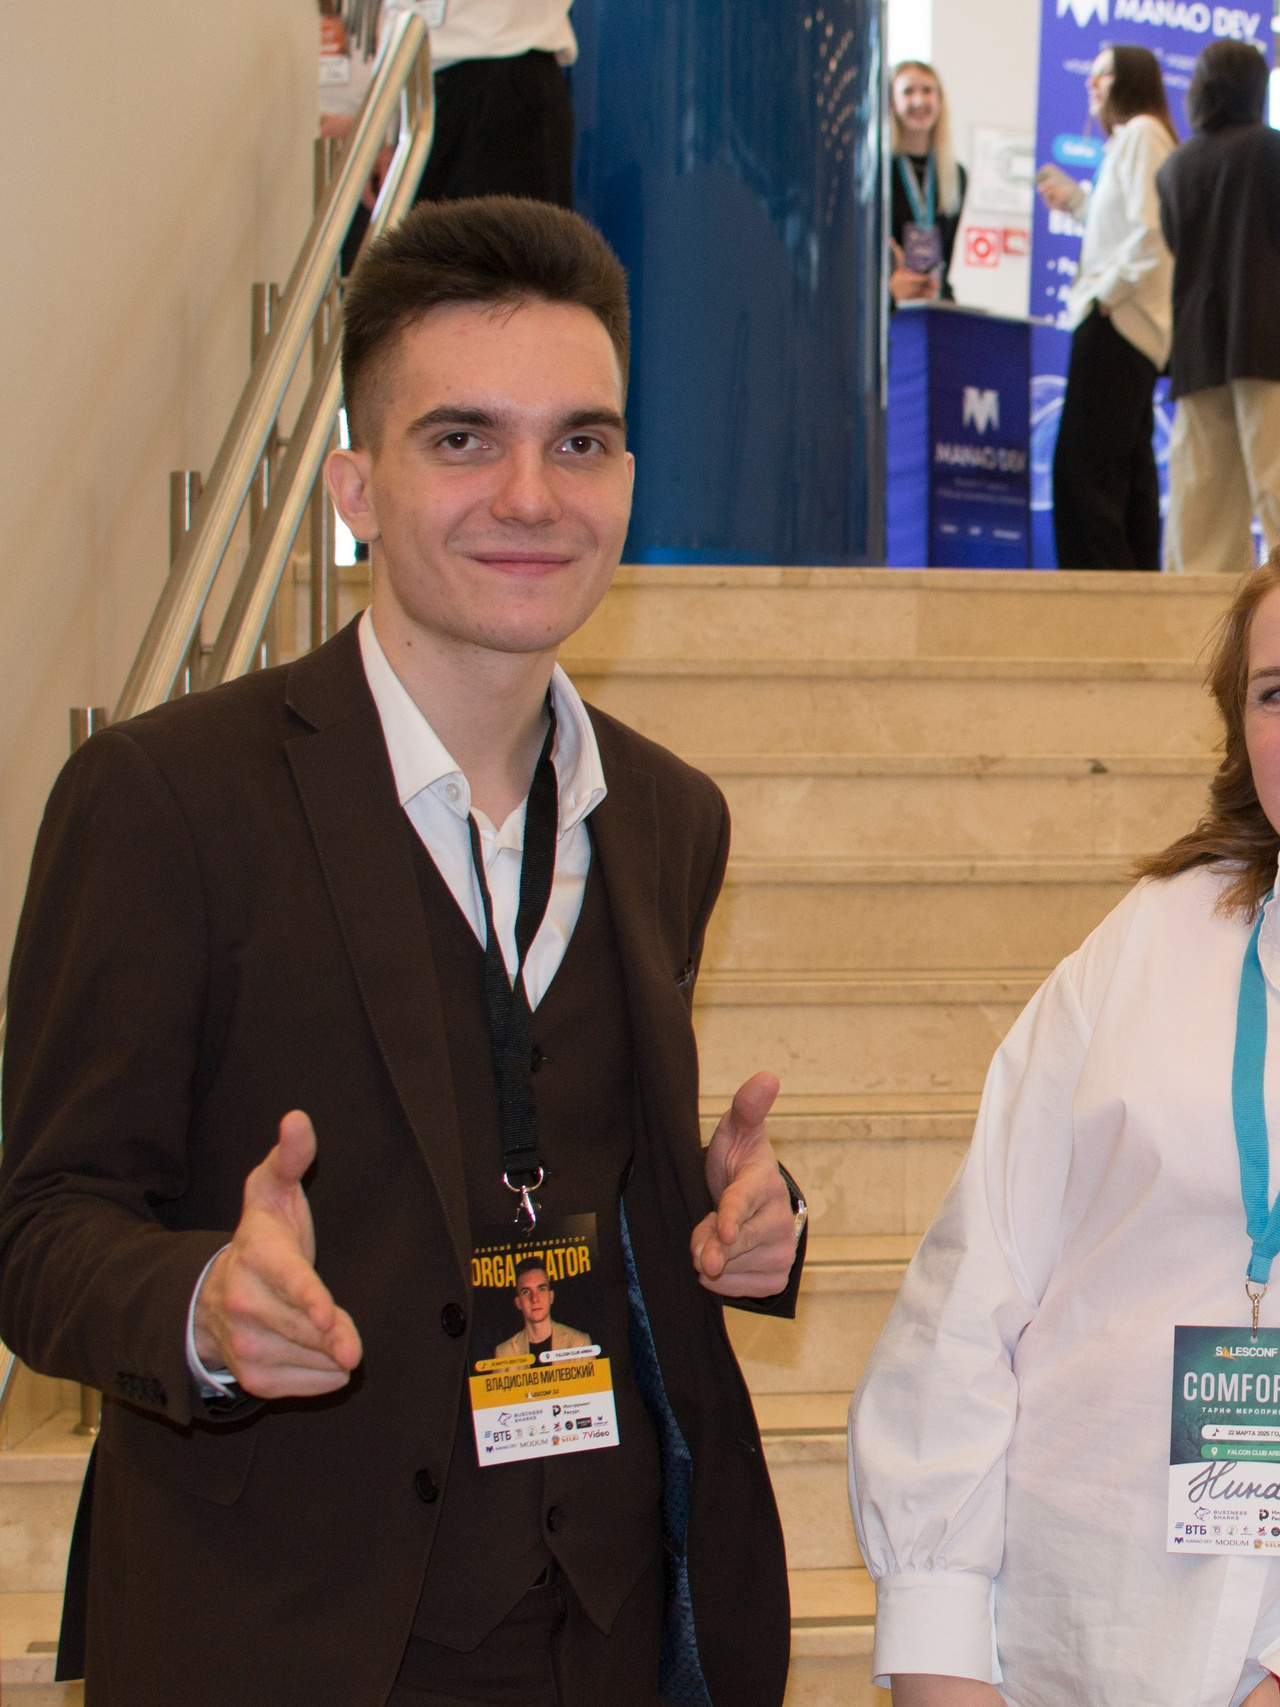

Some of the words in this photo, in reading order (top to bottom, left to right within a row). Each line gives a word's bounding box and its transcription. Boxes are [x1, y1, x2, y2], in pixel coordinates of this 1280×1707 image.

[1212, 6, 1262, 40] DEV
[471, 1245, 591, 1288] ORGAATOR
[486, 1373, 539, 1392] ВЛАДИСЛАВ
[540, 1361, 595, 1383] МИЛЕВСКИЙ
[1202, 1407, 1231, 1415] ТАРИФ
[493, 1430, 512, 1443] ВТБ
[582, 1429, 610, 1440] 7Video
[520, 1439, 549, 1448] MODUM
[1185, 1524, 1207, 1535] ВТБ
